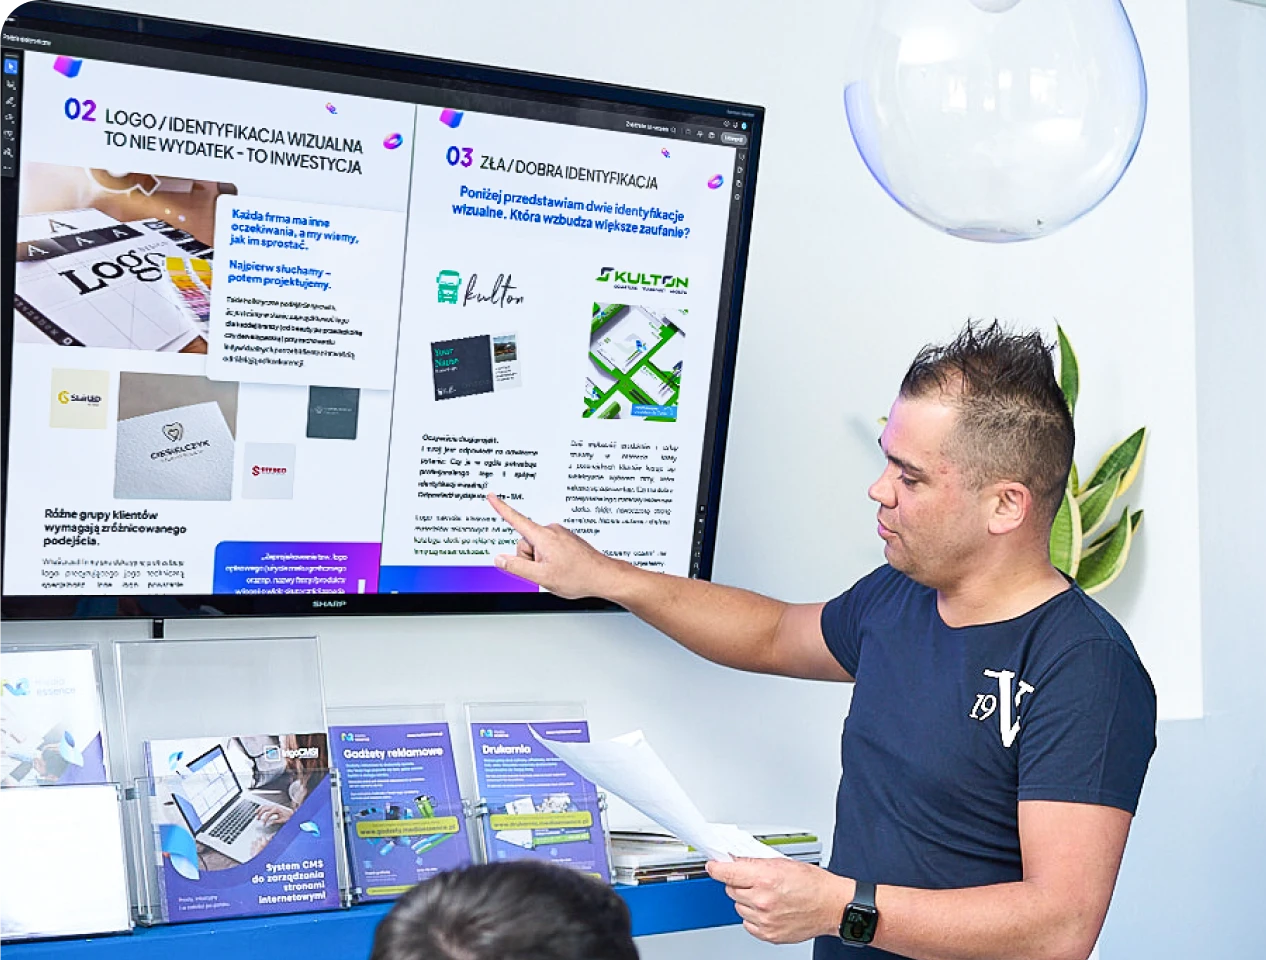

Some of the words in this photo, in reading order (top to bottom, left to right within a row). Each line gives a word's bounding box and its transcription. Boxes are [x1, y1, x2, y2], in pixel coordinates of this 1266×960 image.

[64, 96, 97, 122] 02
[105, 108, 157, 130] LOGO
[169, 116, 285, 145] IDENTYFIKACJA
[287, 131, 363, 154] WIZUALNA
[104, 130, 127, 147] TO
[129, 133, 157, 151] NIE
[158, 137, 234, 160] WYDATEK
[246, 147, 268, 163] TO
[270, 150, 362, 175] INWESTYCJA
[446, 145, 473, 168] 03
[480, 155, 506, 171] ZŁA
[515, 159, 564, 179] DOBRA
[565, 166, 658, 190] IDENTYFIKACJA
[460, 185, 503, 205] Poniżej
[503, 193, 585, 211] przedstawiam
[586, 200, 613, 214] dwie
[614, 202, 685, 224] identyfikacje
[231, 209, 263, 222] Każda
[452, 203, 508, 219] wizualne.
[510, 208, 541, 222] Która
[543, 214, 593, 229] wzbudza
[594, 219, 638, 233] większe
[638, 224, 691, 239] zaufanie?
[614, 270, 689, 289] KULTON
[462, 273, 524, 309] kulton
[44, 507, 78, 519] Różne
[78, 510, 110, 523] grupy
[112, 508, 159, 520] klientów
[43, 523, 101, 535] wymagają
[101, 522, 187, 537] zróżnicowanego
[43, 535, 101, 548] podejścia.
[342, 748, 385, 760] Gadżety
[386, 747, 444, 759] reklamowe
[482, 743, 532, 755] Drukarnia
[265, 861, 300, 874] System
[301, 858, 325, 870] CMS
[251, 874, 266, 885] do
[266, 870, 326, 885] zarządzania
[283, 880, 326, 892] stronami
[258, 890, 327, 905] internetowymi
